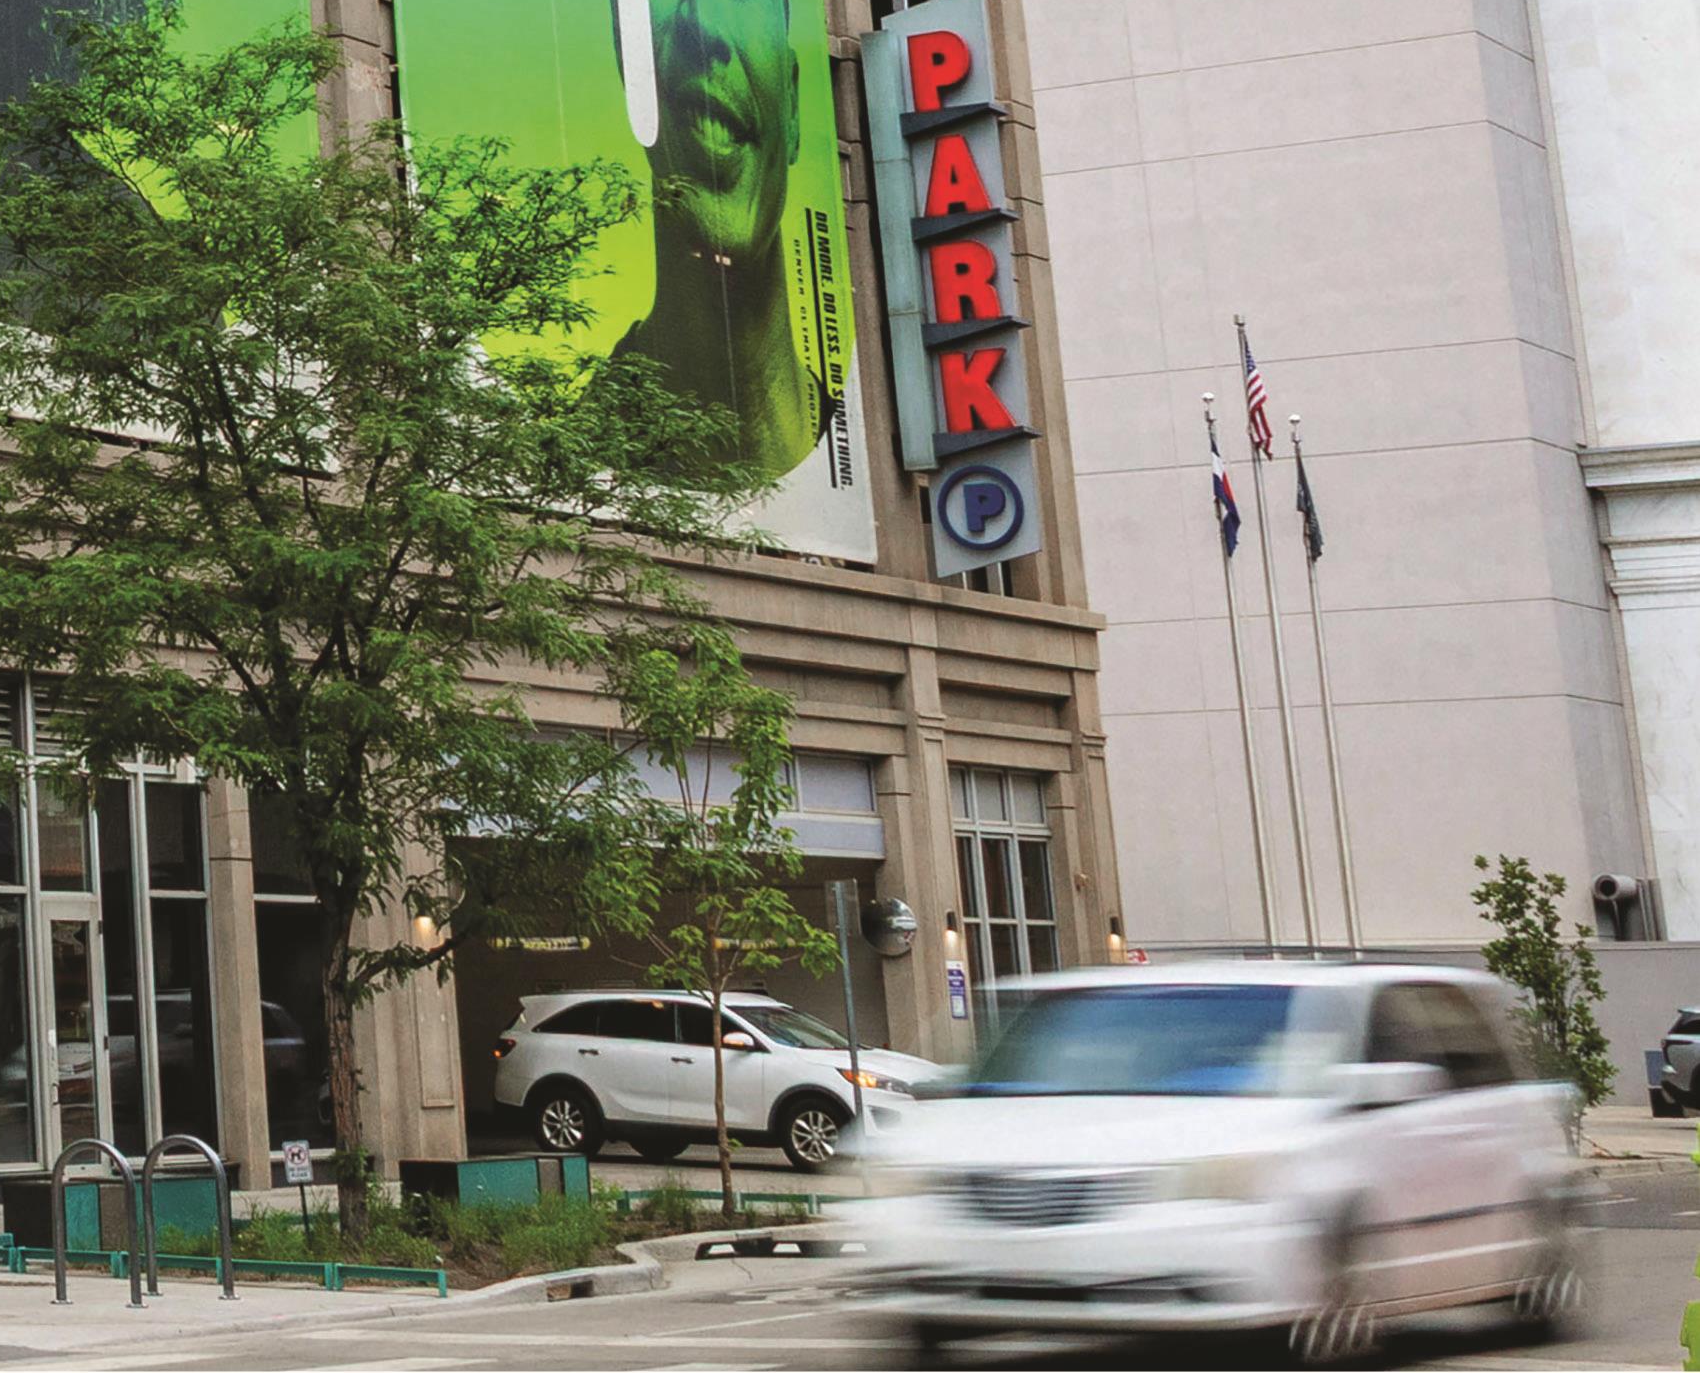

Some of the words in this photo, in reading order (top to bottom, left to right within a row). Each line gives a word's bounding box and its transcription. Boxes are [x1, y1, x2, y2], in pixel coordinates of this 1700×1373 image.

[815, 210, 828, 229] DO
[907, 30, 1017, 433] PARK
[817, 228, 834, 288] MORE.
[823, 292, 837, 315] DO
[824, 314, 841, 360] LESS.
[829, 362, 844, 384] DO
[831, 387, 853, 491] SOMETHING.
[963, 482, 1006, 531] P
